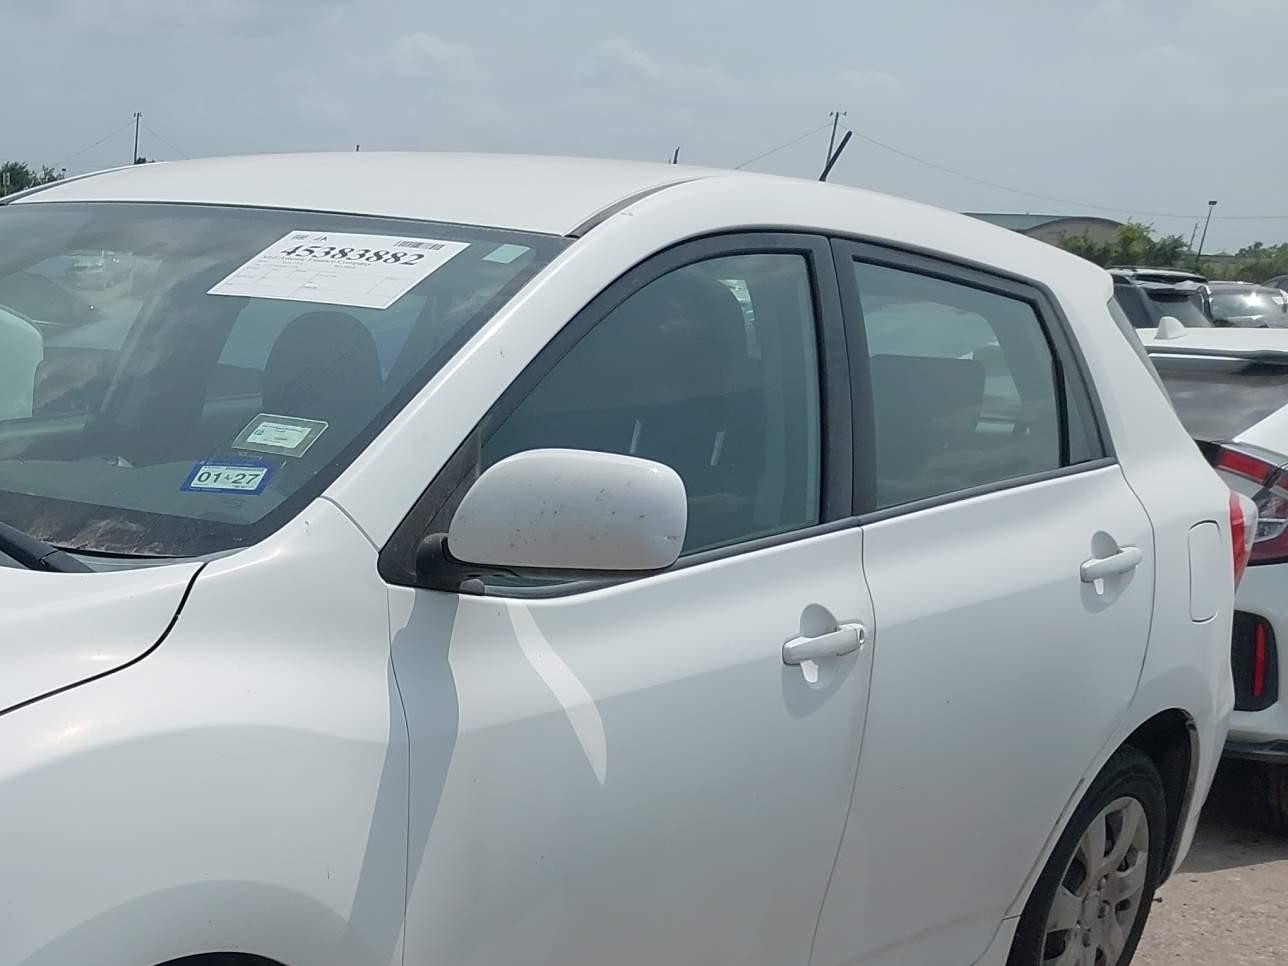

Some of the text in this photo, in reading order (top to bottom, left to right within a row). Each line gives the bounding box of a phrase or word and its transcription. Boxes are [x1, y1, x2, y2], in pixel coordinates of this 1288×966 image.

[281, 244, 425, 266] 45383882
[197, 471, 260, 484] 01 27
